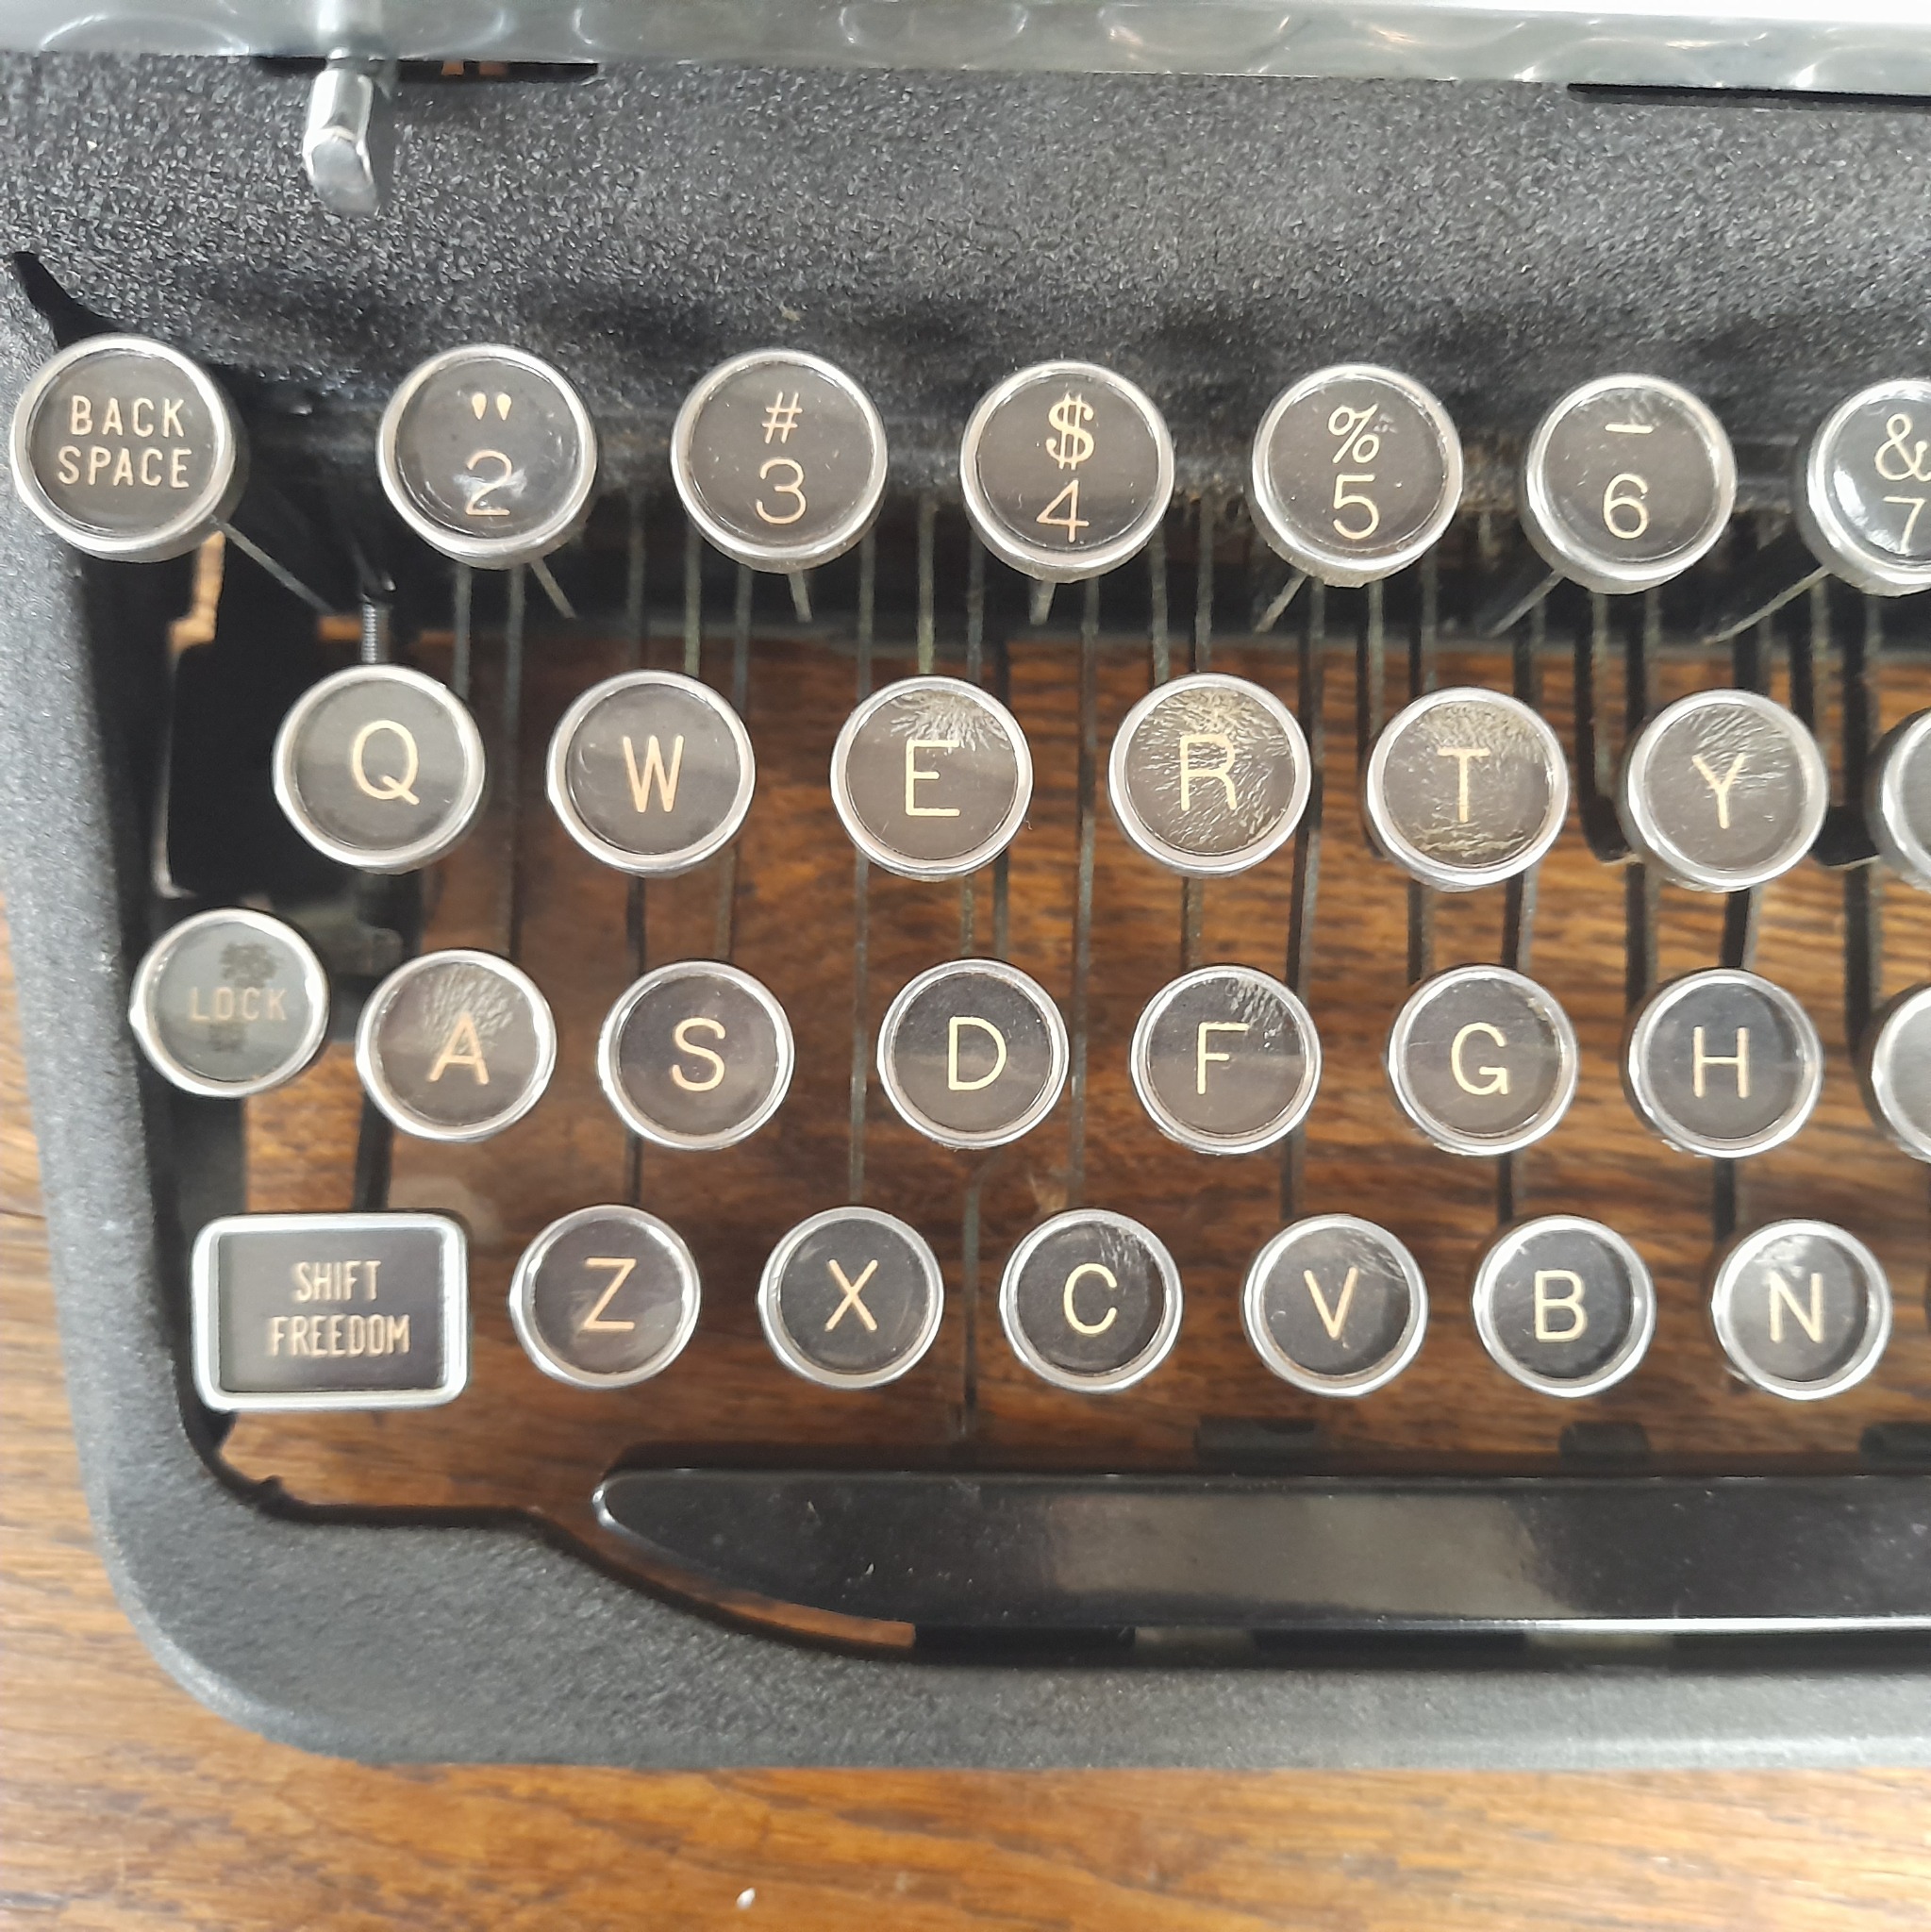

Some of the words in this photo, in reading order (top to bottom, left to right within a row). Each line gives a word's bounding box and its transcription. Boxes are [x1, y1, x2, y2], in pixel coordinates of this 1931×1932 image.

[69, 393, 186, 439] BACK
[761, 391, 804, 444] #
[1044, 391, 1095, 471] $
[1327, 403, 1381, 465] %
[1873, 412, 1931, 483] &
[57, 444, 192, 490] SPACE
[464, 449, 513, 517] 2
[755, 458, 807, 525] 3
[1036, 479, 1089, 541] 4
[1331, 474, 1380, 541] 5
[1603, 472, 1650, 540] 6
[1883, 494, 1927, 555] 7
[350, 719, 420, 805] Q
[623, 735, 685, 812] W
[903, 739, 959, 819] E
[1178, 732, 1237, 813] R
[1437, 746, 1490, 825] T
[1691, 752, 1746, 830] Y
[189, 986, 287, 1023] LOCK
[428, 1014, 489, 1084] A
[670, 1016, 724, 1094] S
[947, 1015, 1007, 1093] D
[1197, 1021, 1248, 1096] F
[1448, 1022, 1509, 1099] G
[1692, 1024, 1750, 1098] H
[292, 1260, 382, 1303] SHIFT
[582, 1257, 635, 1333] Z
[826, 1258, 876, 1334] X
[1063, 1261, 1117, 1336] C
[1304, 1265, 1355, 1341] V
[1535, 1267, 1586, 1343] B
[1768, 1267, 1826, 1343] N
[267, 1315, 411, 1357] FREEDOM
